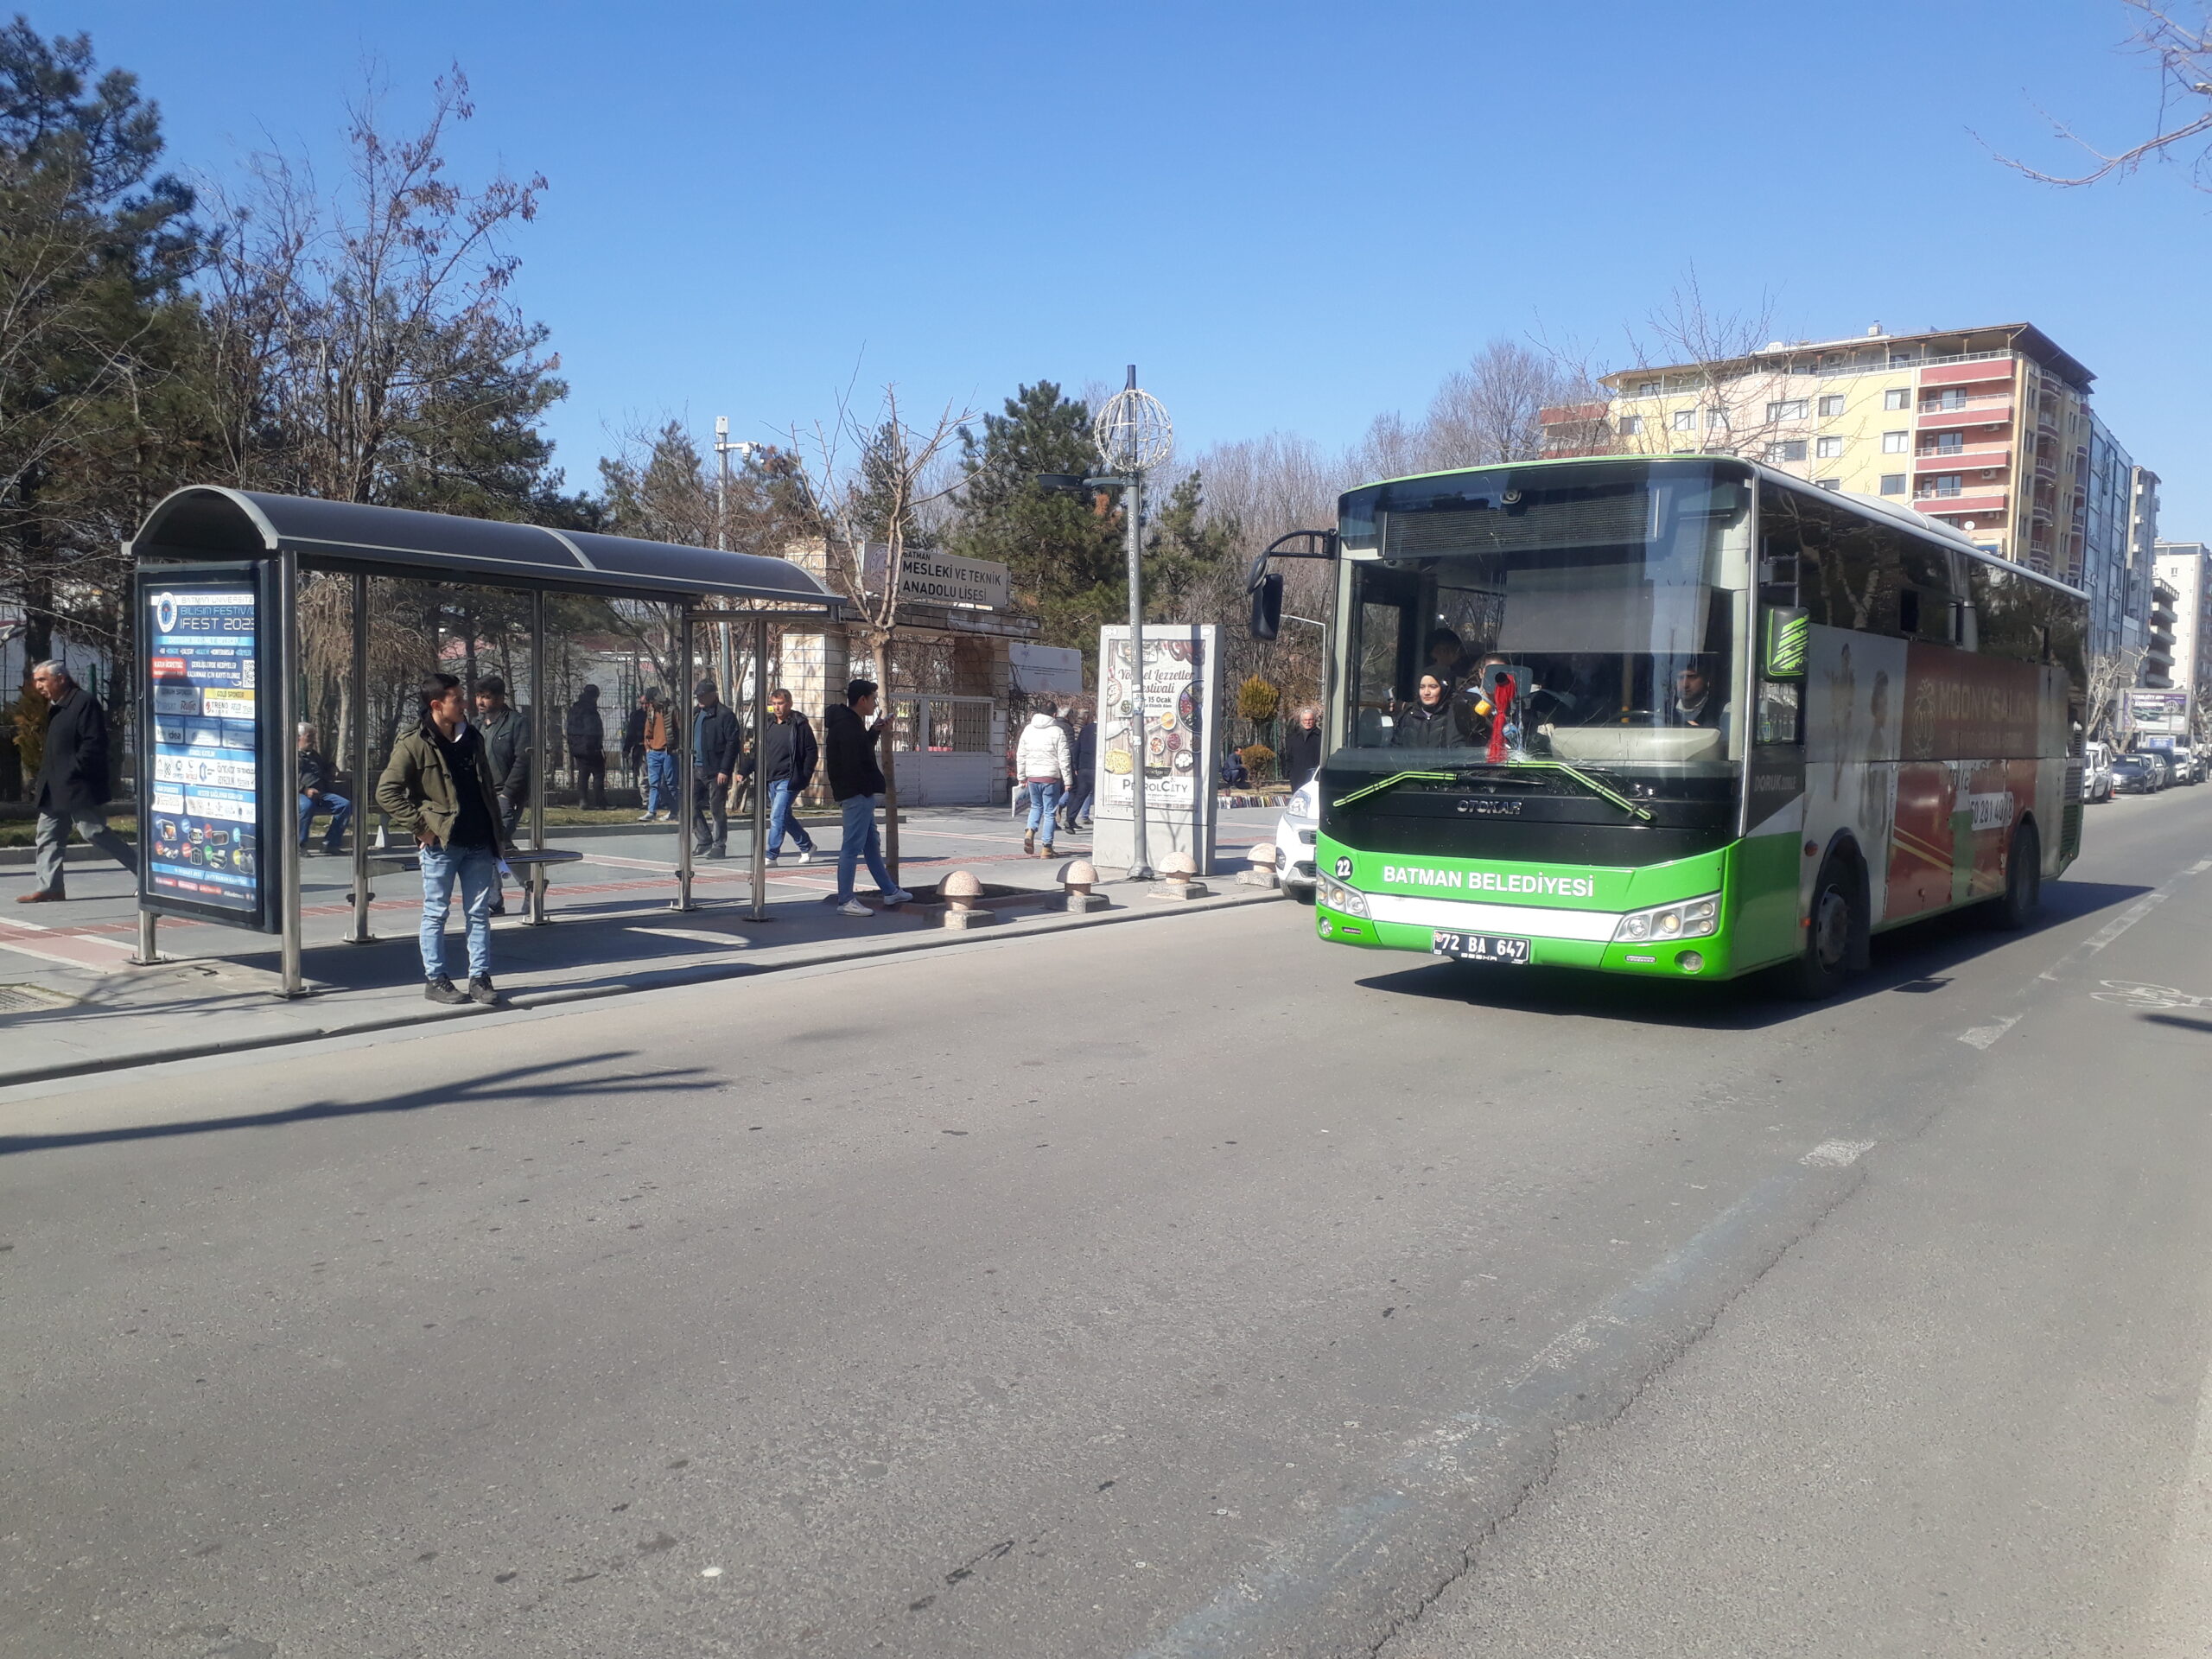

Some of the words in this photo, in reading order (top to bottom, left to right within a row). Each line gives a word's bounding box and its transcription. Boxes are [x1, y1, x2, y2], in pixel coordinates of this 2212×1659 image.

[902, 550, 931, 562] BATMAN
[903, 560, 953, 579] MESLEKİ
[956, 568, 966, 581] VE
[969, 569, 1001, 587] TEKNİK
[903, 580, 956, 599] ANADOLU
[958, 585, 987, 602] LİSESİ
[1154, 669, 1195, 683] Lezzetler
[1143, 683, 1175, 694] estivali
[1122, 779, 1188, 793] PEROLCITY
[1755, 772, 1781, 792] DORUK
[1457, 799, 1522, 815] OTOKAR
[1337, 859, 1351, 876] 22
[1382, 865, 1462, 889] BATMAN
[1468, 870, 1594, 898] BELEDİYESİ
[1441, 933, 1459, 951] 72
[1468, 936, 1486, 954] BA
[1497, 940, 1525, 958] 647
